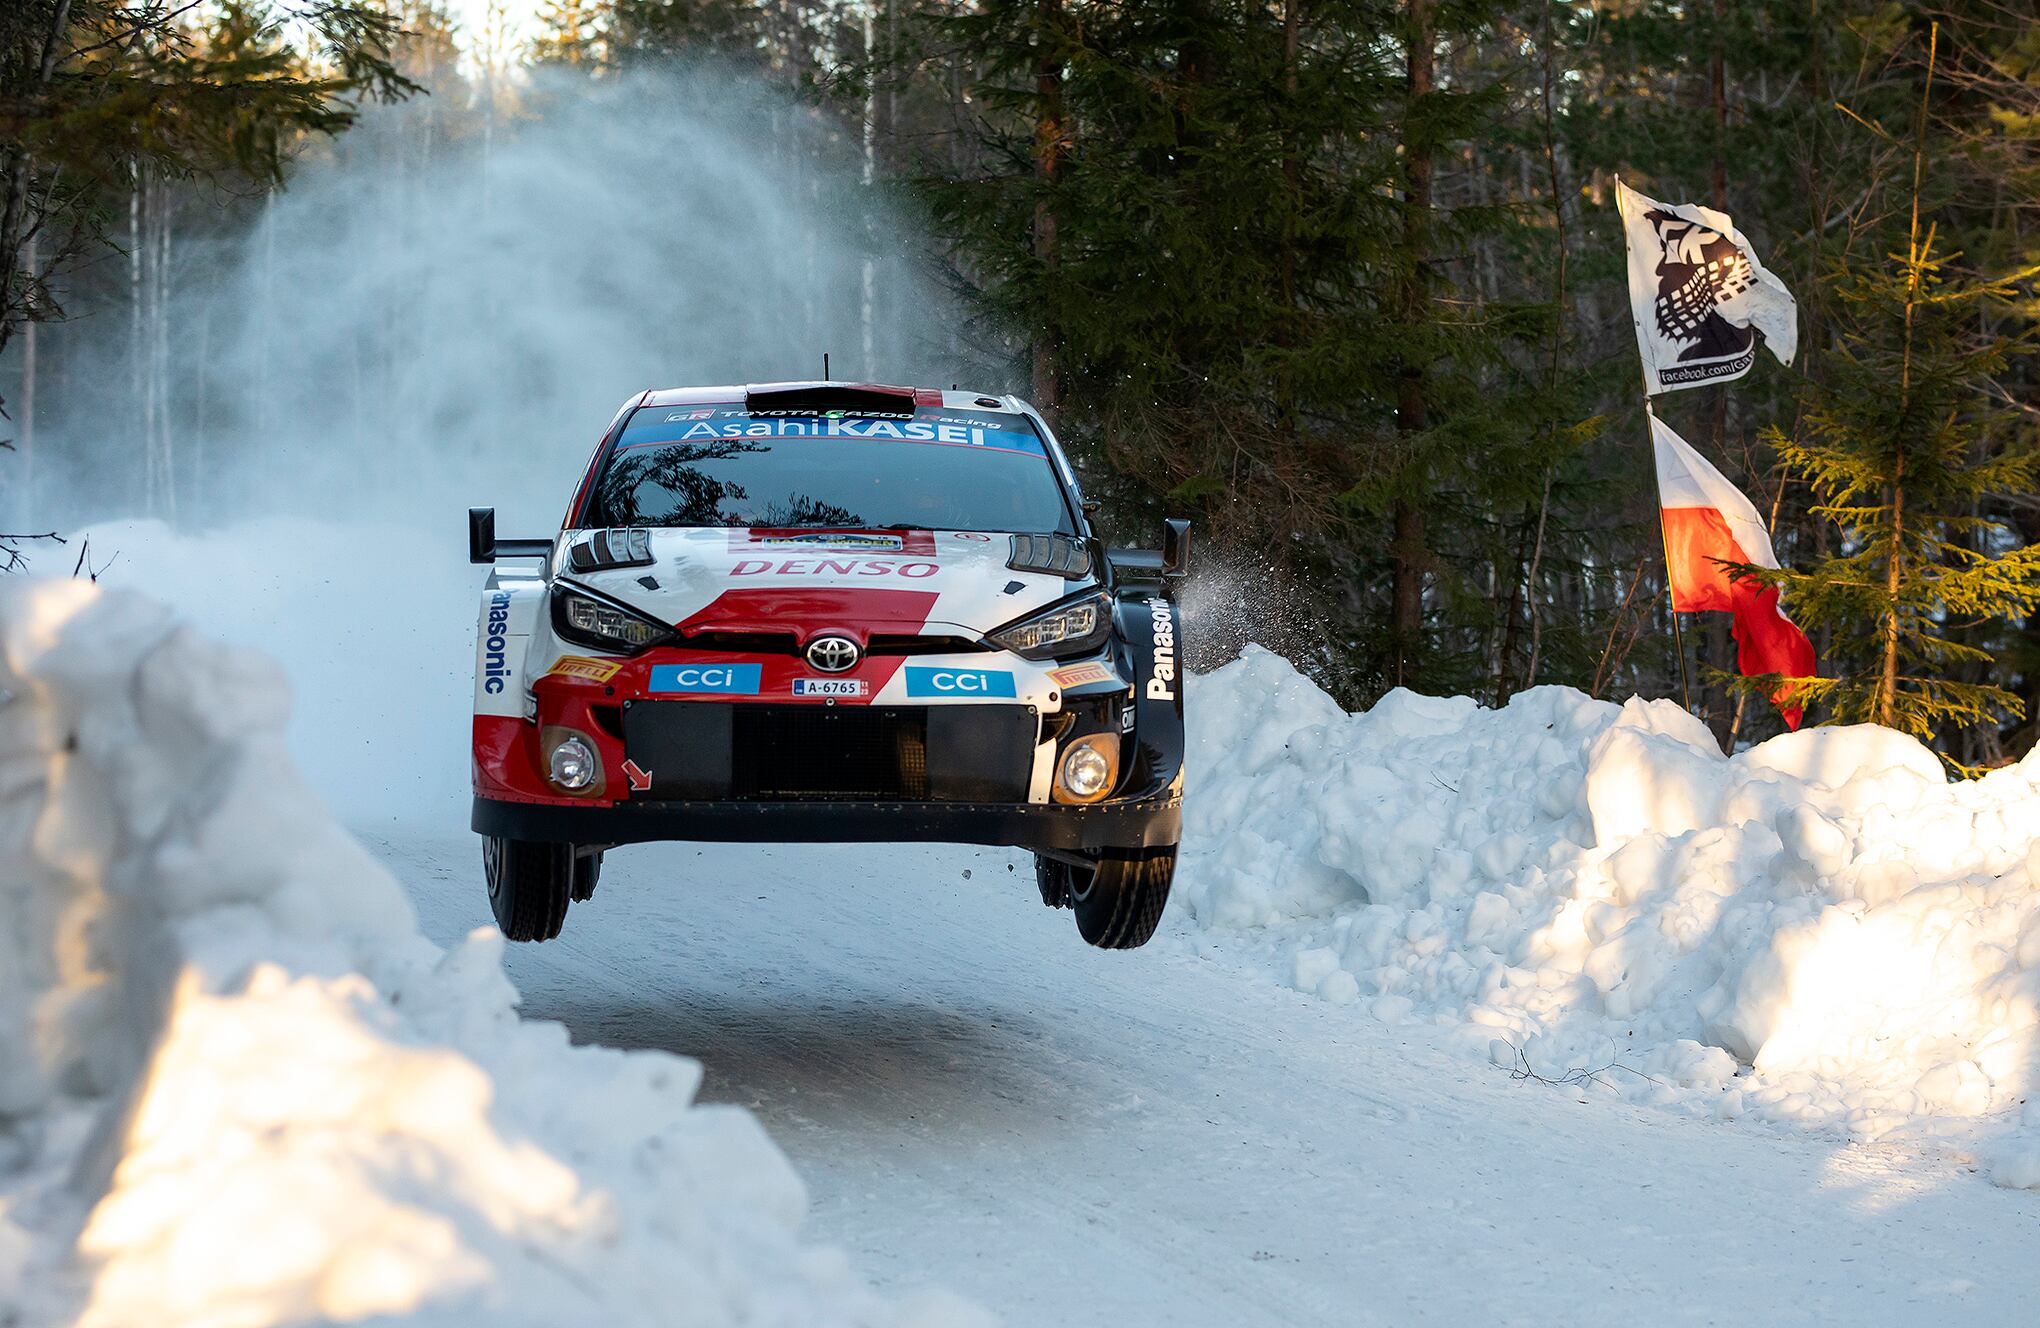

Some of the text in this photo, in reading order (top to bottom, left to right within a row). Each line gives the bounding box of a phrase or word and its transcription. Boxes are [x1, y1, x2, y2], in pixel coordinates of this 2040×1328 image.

[720, 409, 818, 418] TOYOTA
[825, 409, 914, 419] GAZOO
[919, 414, 1002, 430] Racing
[729, 559, 940, 578] DENSO
[553, 658, 615, 678] PIRELLI
[808, 682, 856, 693] A-6765
